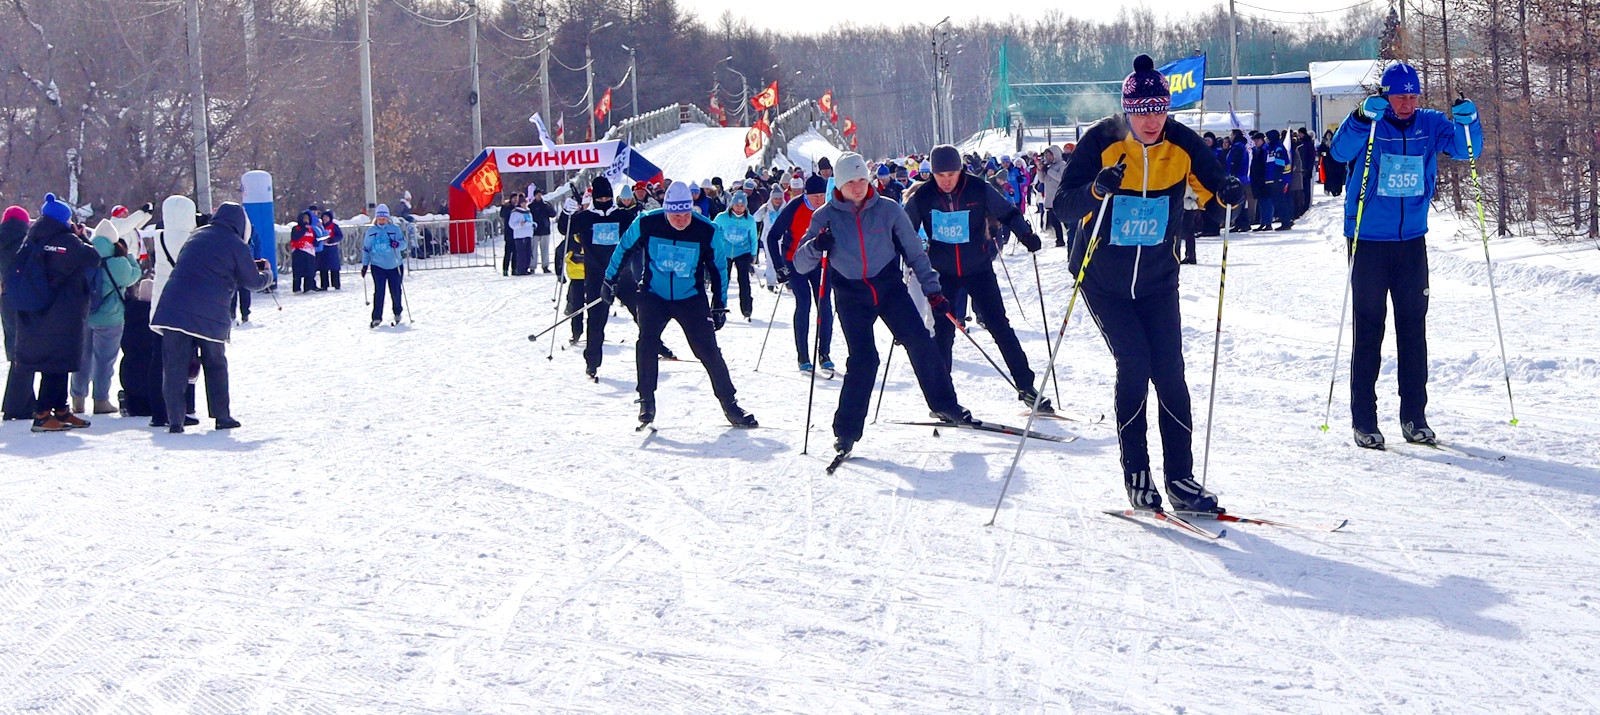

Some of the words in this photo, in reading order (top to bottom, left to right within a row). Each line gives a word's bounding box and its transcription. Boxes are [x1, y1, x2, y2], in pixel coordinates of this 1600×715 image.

[507, 149, 599, 167] ФИНИШ
[1388, 173, 1418, 188] 5355
[938, 225, 963, 237] 4882
[1121, 219, 1158, 236] 4702
